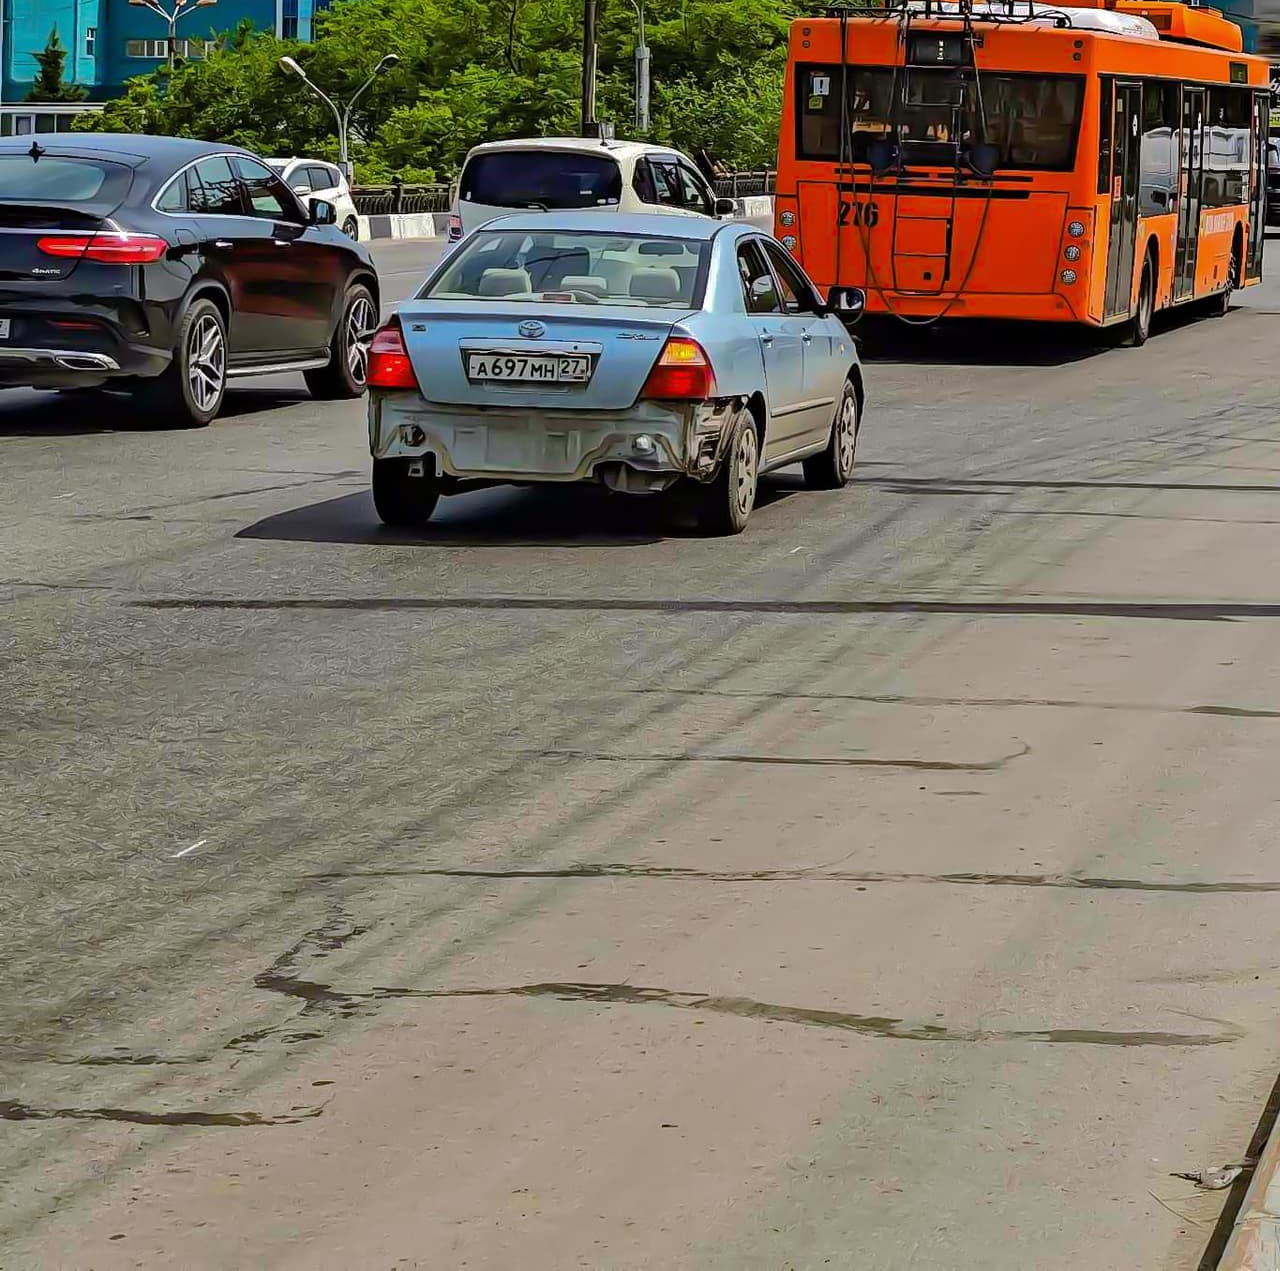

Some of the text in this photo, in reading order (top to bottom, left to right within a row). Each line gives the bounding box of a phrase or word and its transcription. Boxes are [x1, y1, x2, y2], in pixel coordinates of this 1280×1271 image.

[837, 200, 880, 228] 276
[475, 357, 580, 379] А697МН 27
